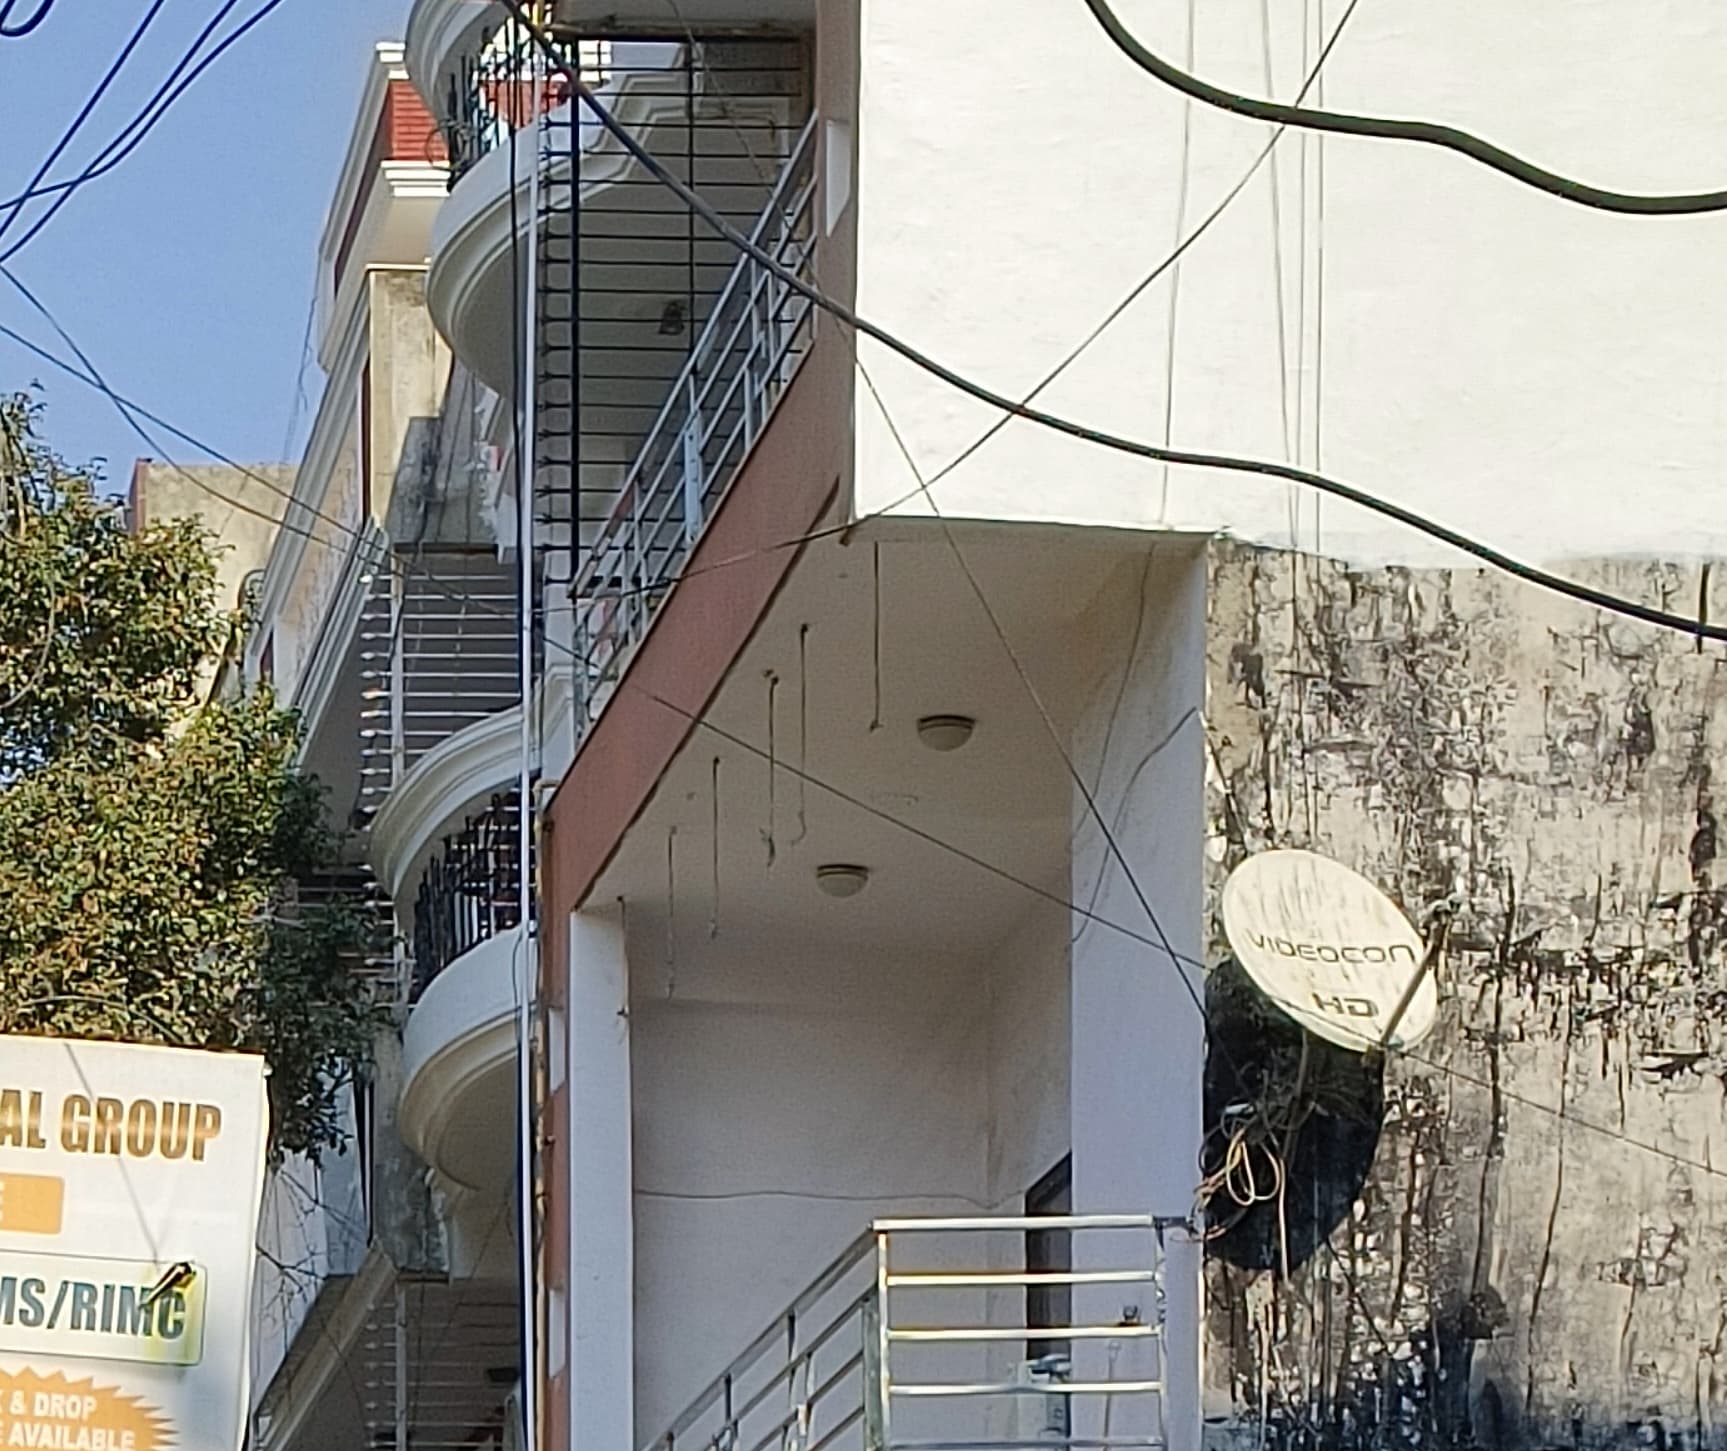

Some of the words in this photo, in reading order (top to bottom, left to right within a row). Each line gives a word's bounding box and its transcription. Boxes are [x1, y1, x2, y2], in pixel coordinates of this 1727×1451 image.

[1311, 992, 1379, 1018] HD
[61, 1094, 222, 1161] GROUP
[9, 1390, 27, 1415] &
[33, 1392, 97, 1420] DROP
